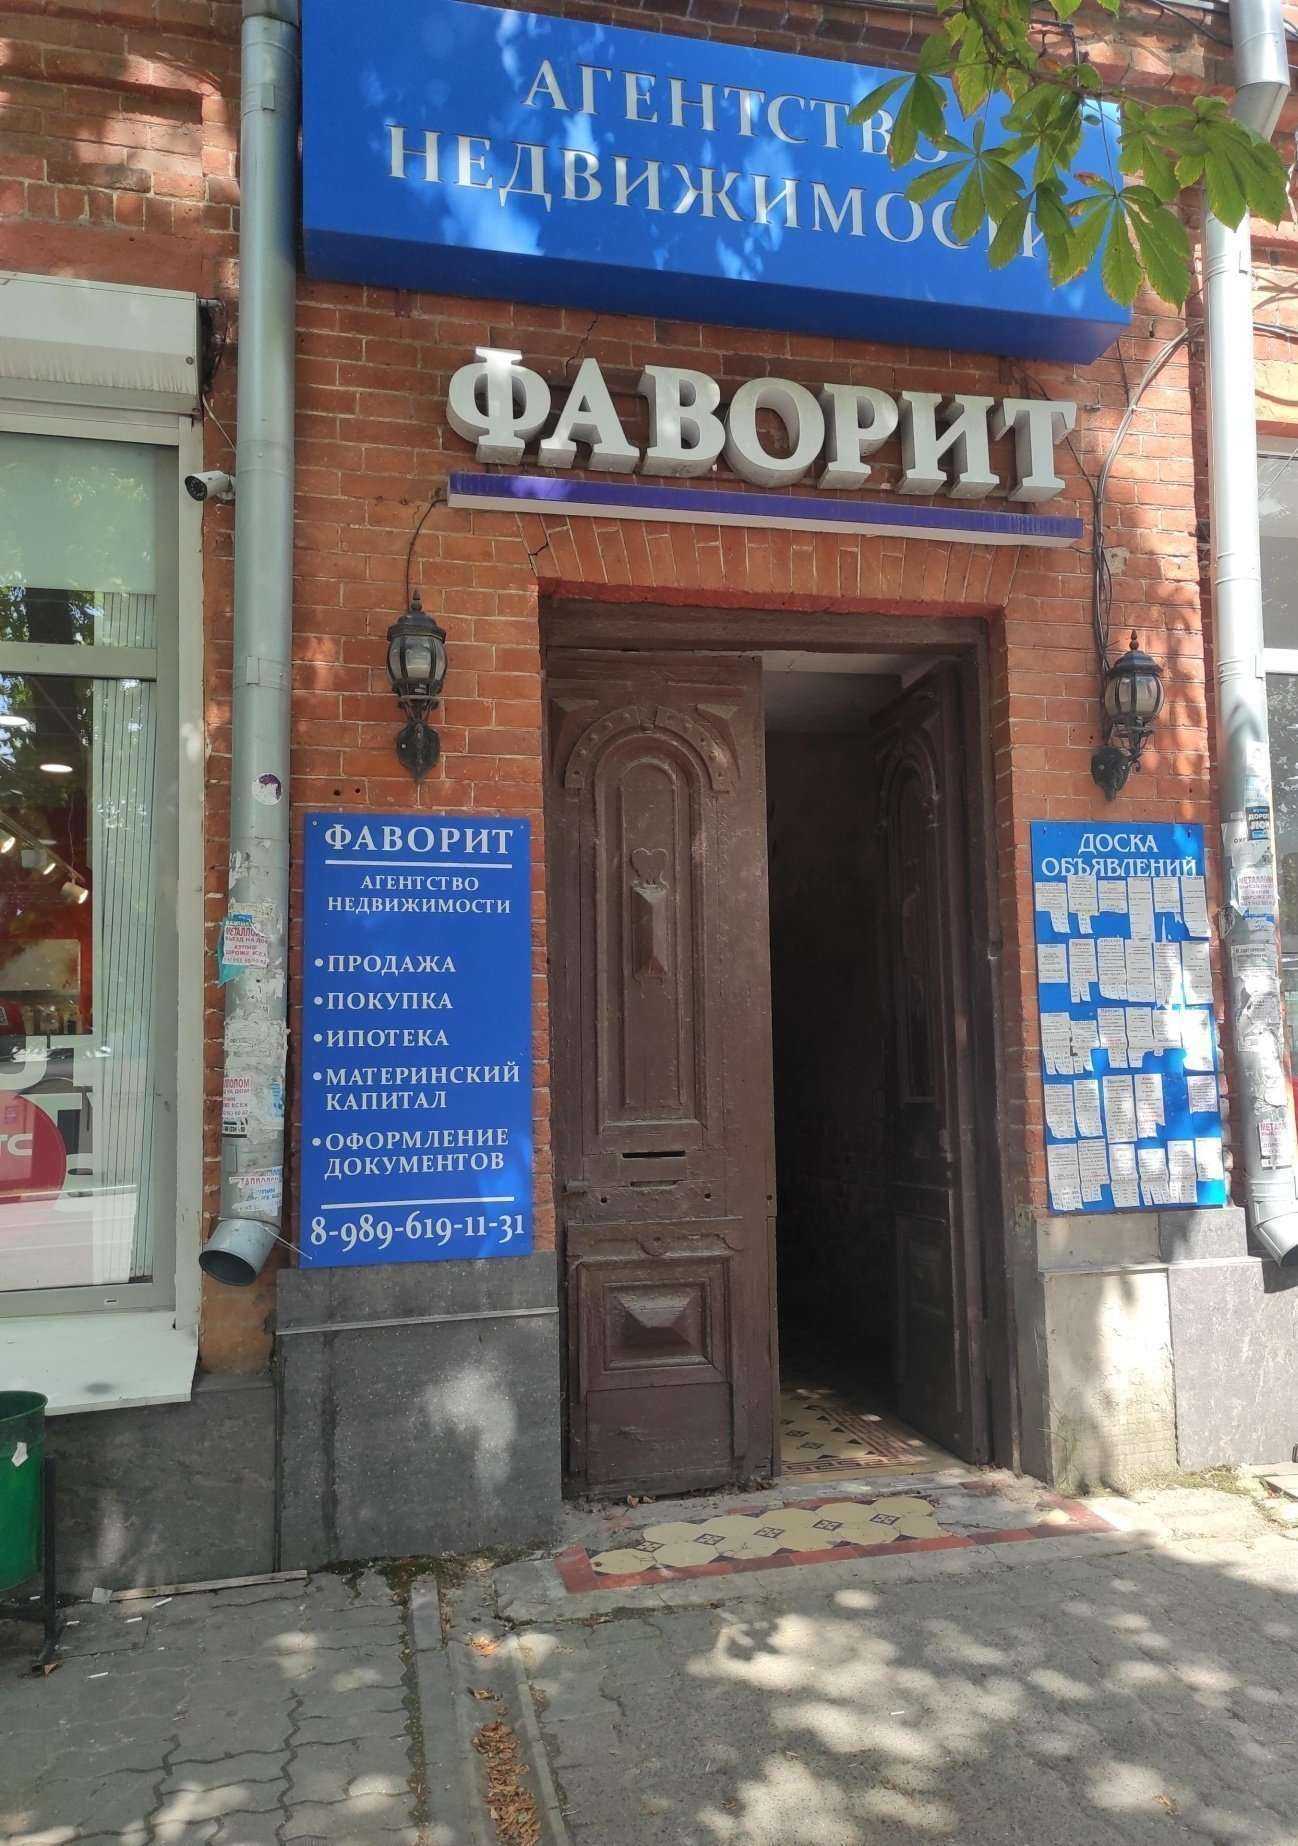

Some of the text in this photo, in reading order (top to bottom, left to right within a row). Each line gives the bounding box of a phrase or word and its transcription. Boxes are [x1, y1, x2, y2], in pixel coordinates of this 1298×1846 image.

[522, 58, 949, 163] АГЕНТСТВ
[384, 124, 1048, 259] НЕДВИЖИМОС
[446, 345, 1076, 501] ФАВОРИТ
[324, 823, 513, 854] ФАВОРИТ
[1077, 834, 1159, 855] ДОСКА
[1041, 856, 1197, 877] ОБЪЯВЛЕНИЙ
[361, 875, 479, 891] АГЕНТСТВО
[327, 896, 511, 915] НЕДВИЖИМОСТИ
[327, 955, 457, 976] ПРОДАЖА
[326, 992, 454, 1010] ПОКУПКА
[326, 1029, 449, 1048] ИПОТЕКА
[325, 1061, 520, 1086] МАТЕРИНСКИЙ
[325, 1091, 448, 1111] КАПИТАЛ
[325, 1128, 509, 1151] ОФОРМЛЕНИЕ
[324, 1152, 505, 1180] ДОКУМЕНТОВ
[310, 1210, 525, 1252] 8-989-619-11-31
